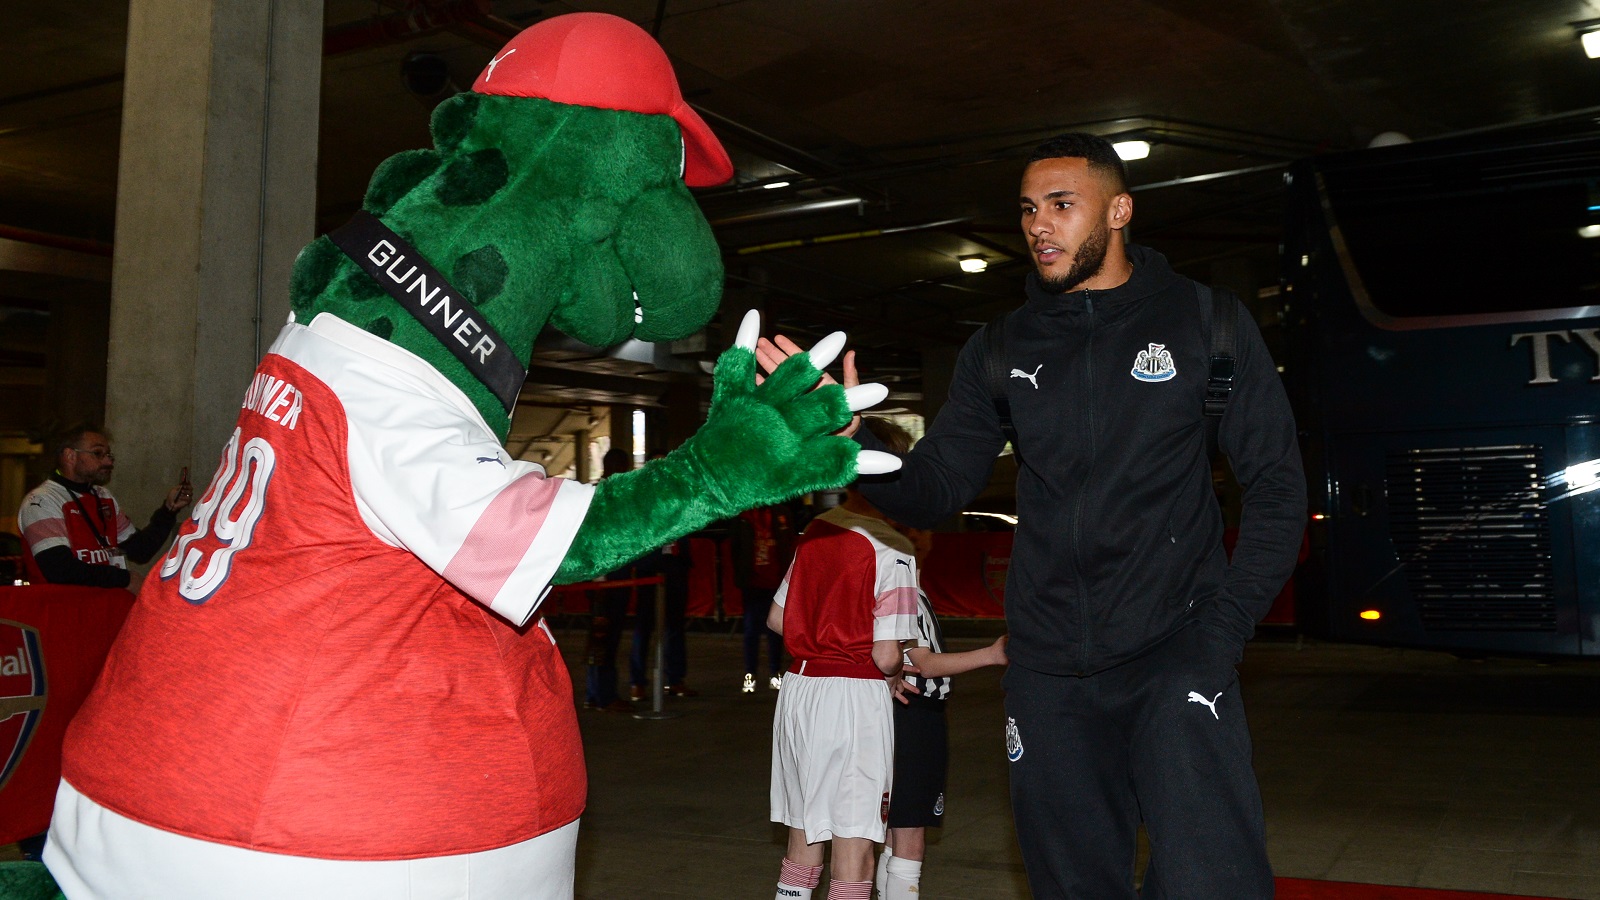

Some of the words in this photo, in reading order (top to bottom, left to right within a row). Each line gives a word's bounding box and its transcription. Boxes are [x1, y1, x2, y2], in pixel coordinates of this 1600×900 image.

[367, 239, 497, 364] GUNNER
[160, 427, 275, 604] 99
[0, 647, 28, 676] al
